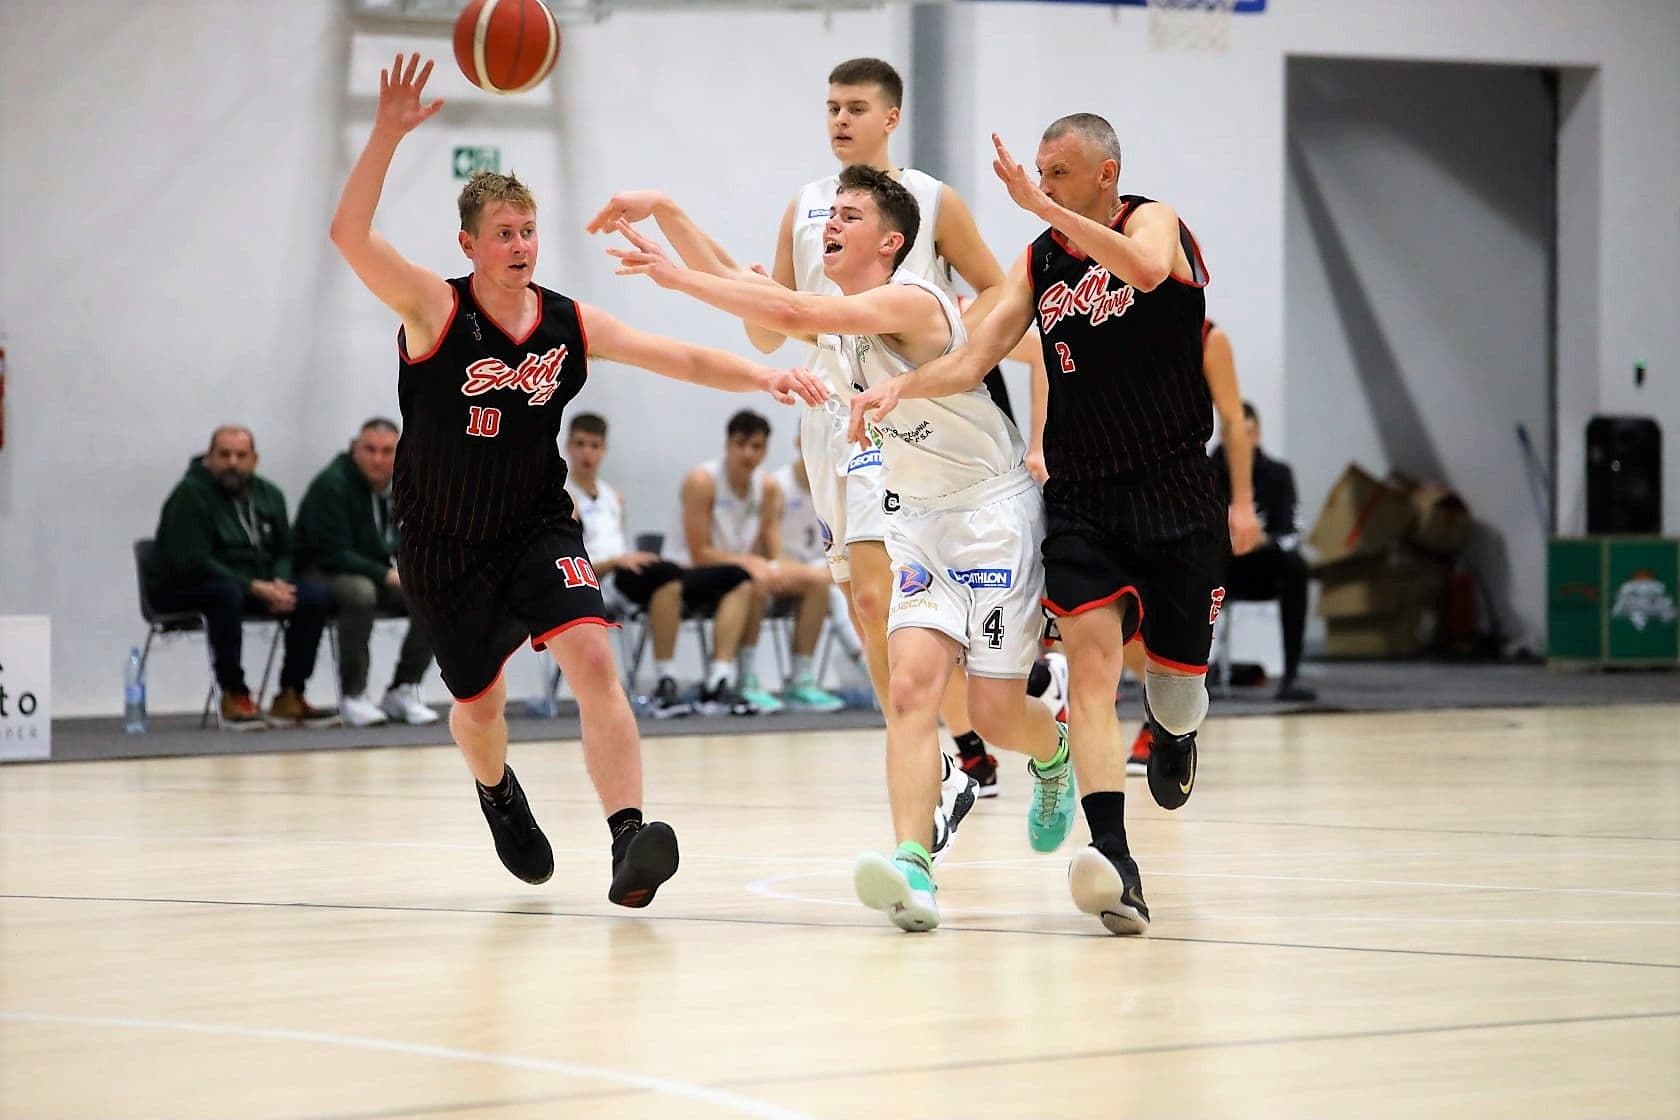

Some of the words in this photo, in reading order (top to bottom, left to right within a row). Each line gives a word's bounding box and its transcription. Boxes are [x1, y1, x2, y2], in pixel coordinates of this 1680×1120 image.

[1055, 341, 1076, 373] 2
[466, 405, 501, 438] 10
[555, 556, 599, 590] 10
[982, 606, 1004, 649] 4
